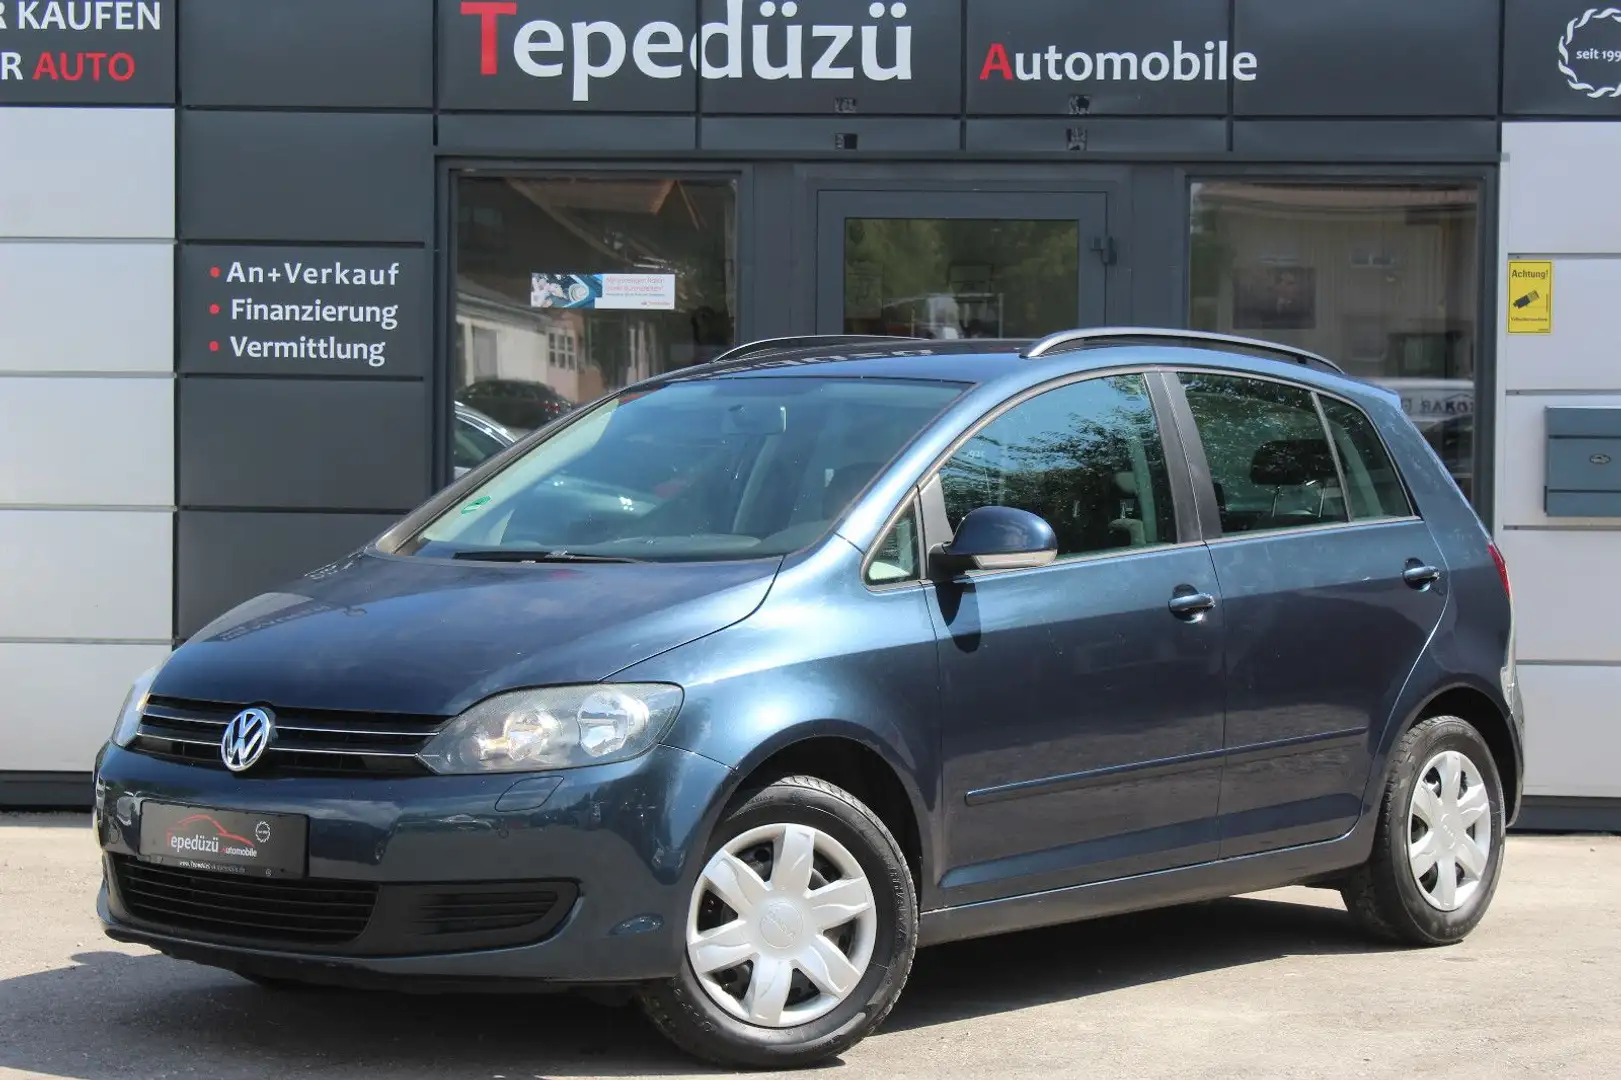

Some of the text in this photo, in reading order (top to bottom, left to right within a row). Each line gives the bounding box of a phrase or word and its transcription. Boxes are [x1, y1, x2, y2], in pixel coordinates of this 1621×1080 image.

[18, 1, 161, 30] KAUFEN
[460, 0, 1258, 102] Tepedüzü Automobile
[1576, 48, 1599, 60] seit
[32, 51, 136, 82] AUTO
[226, 262, 400, 285] An+Verkauf
[1511, 269, 1549, 280] Achtung!
[231, 298, 399, 330] Finanzierung
[230, 336, 386, 366] Vermittlung
